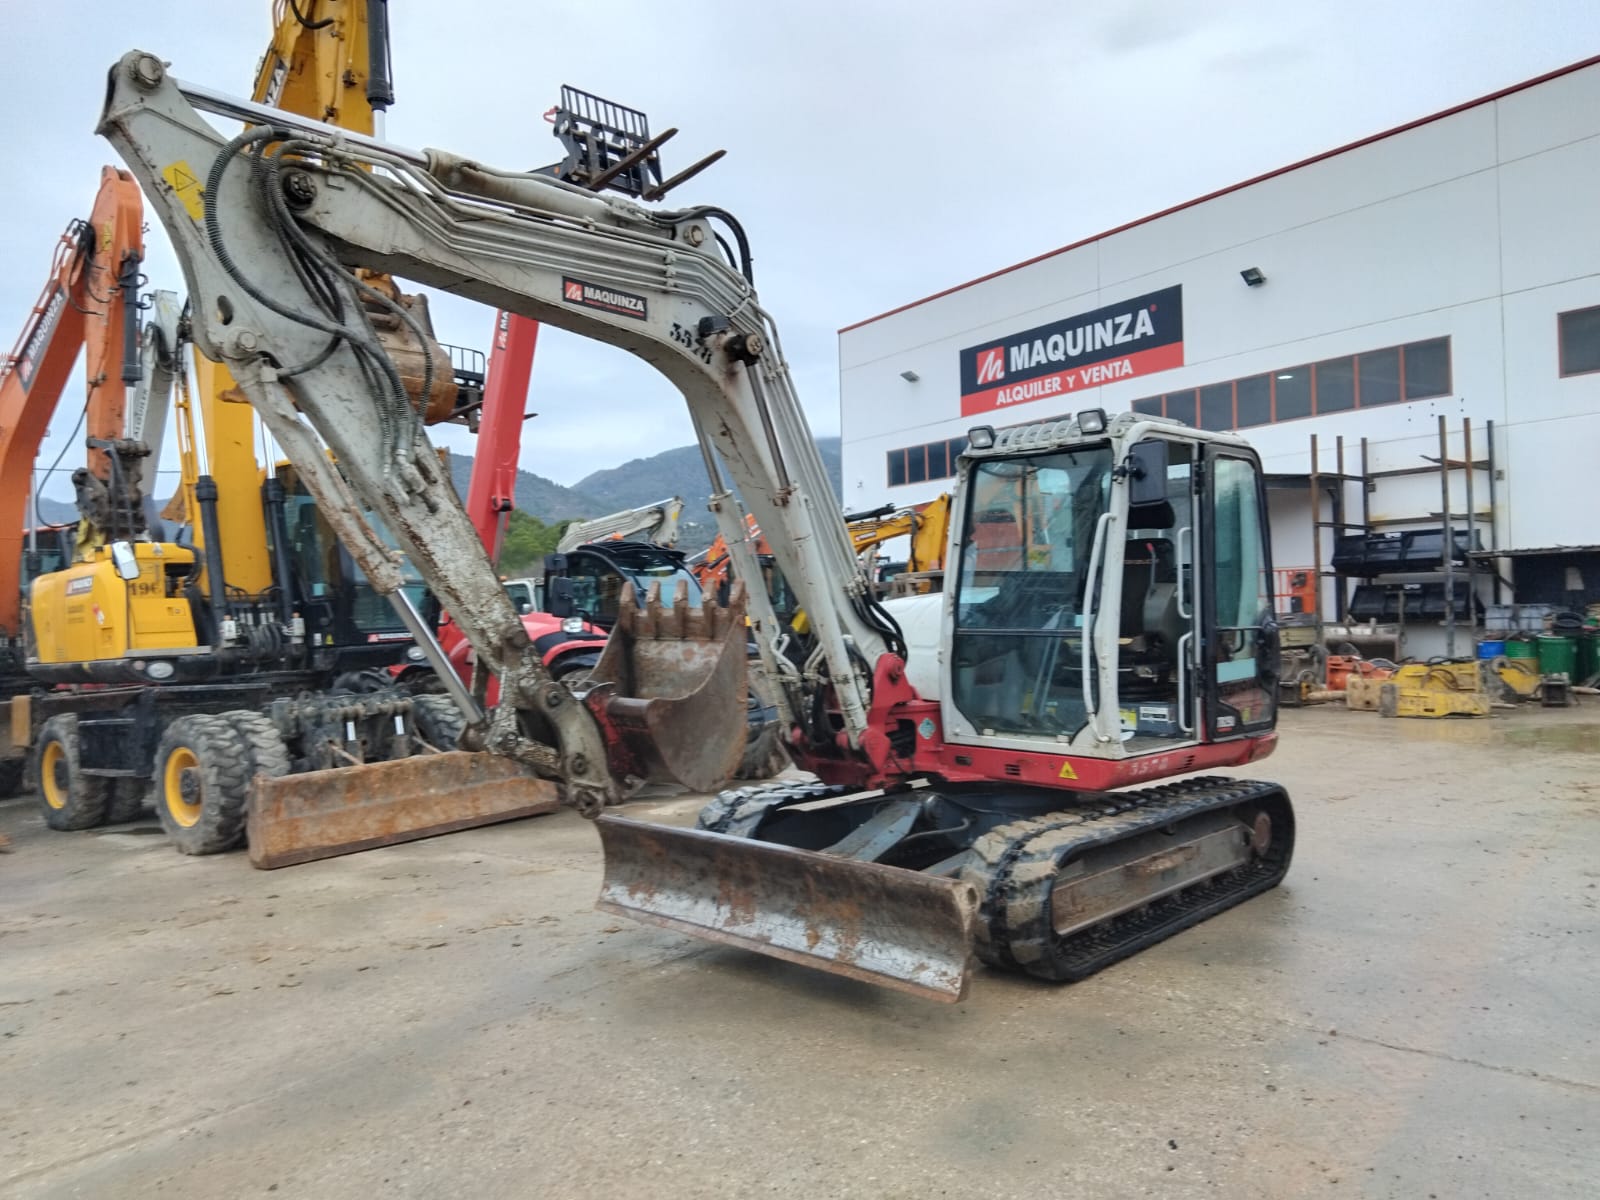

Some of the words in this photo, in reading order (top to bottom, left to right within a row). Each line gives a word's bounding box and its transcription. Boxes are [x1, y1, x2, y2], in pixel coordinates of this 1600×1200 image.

[584, 286, 645, 312] MAQUINZA
[1010, 308, 1155, 372] MAQUINZA
[996, 376, 1062, 405] ALQUILER
[1066, 375, 1076, 389] Y
[1080, 359, 1133, 385] VENTA
